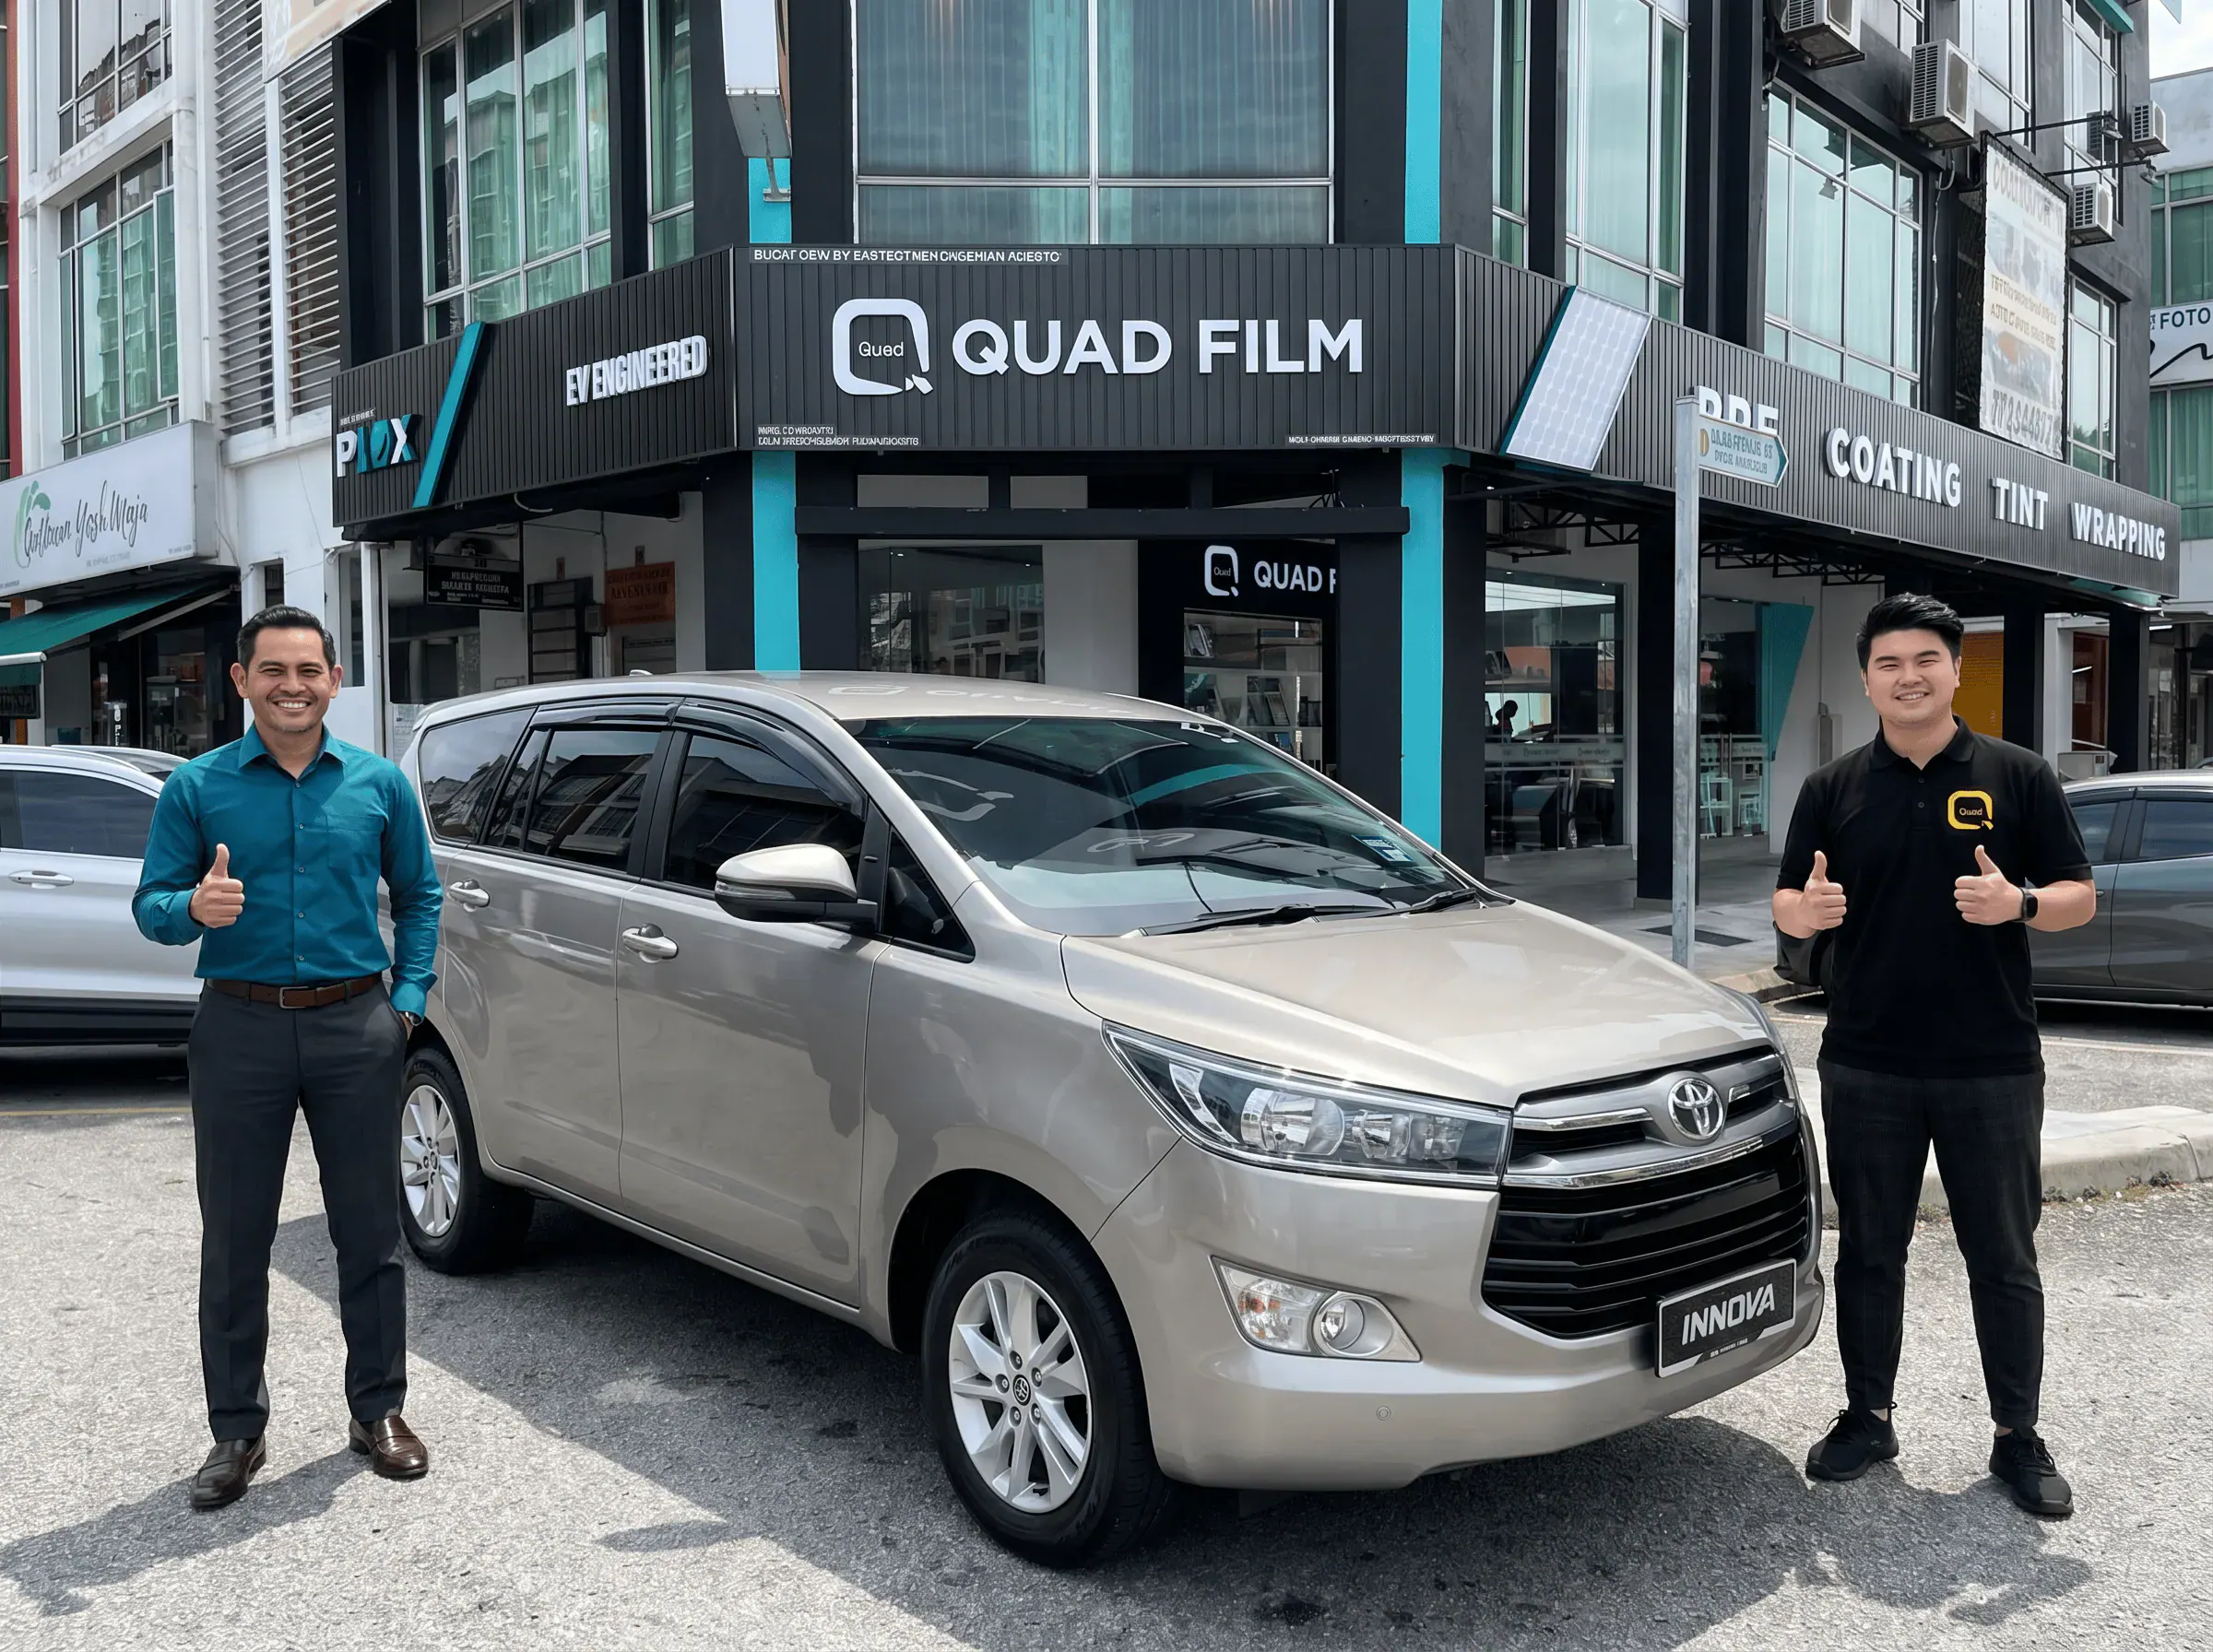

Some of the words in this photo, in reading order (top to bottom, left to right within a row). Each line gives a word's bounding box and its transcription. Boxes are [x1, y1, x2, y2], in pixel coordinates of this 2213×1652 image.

[833, 250, 850, 261] BY
[952, 318, 1172, 376] QUAD
[1199, 318, 1363, 374] FILM
[2160, 307, 2211, 330] FOTO
[566, 364, 591, 407] EV
[592, 335, 708, 400] ENGINEERED
[1826, 427, 1961, 507] COATING
[1992, 477, 2049, 531] TINT
[2069, 501, 2166, 561] WRAPPING
[1253, 560, 1323, 593] QUAD
[1681, 1282, 1775, 1346] INNOVA
